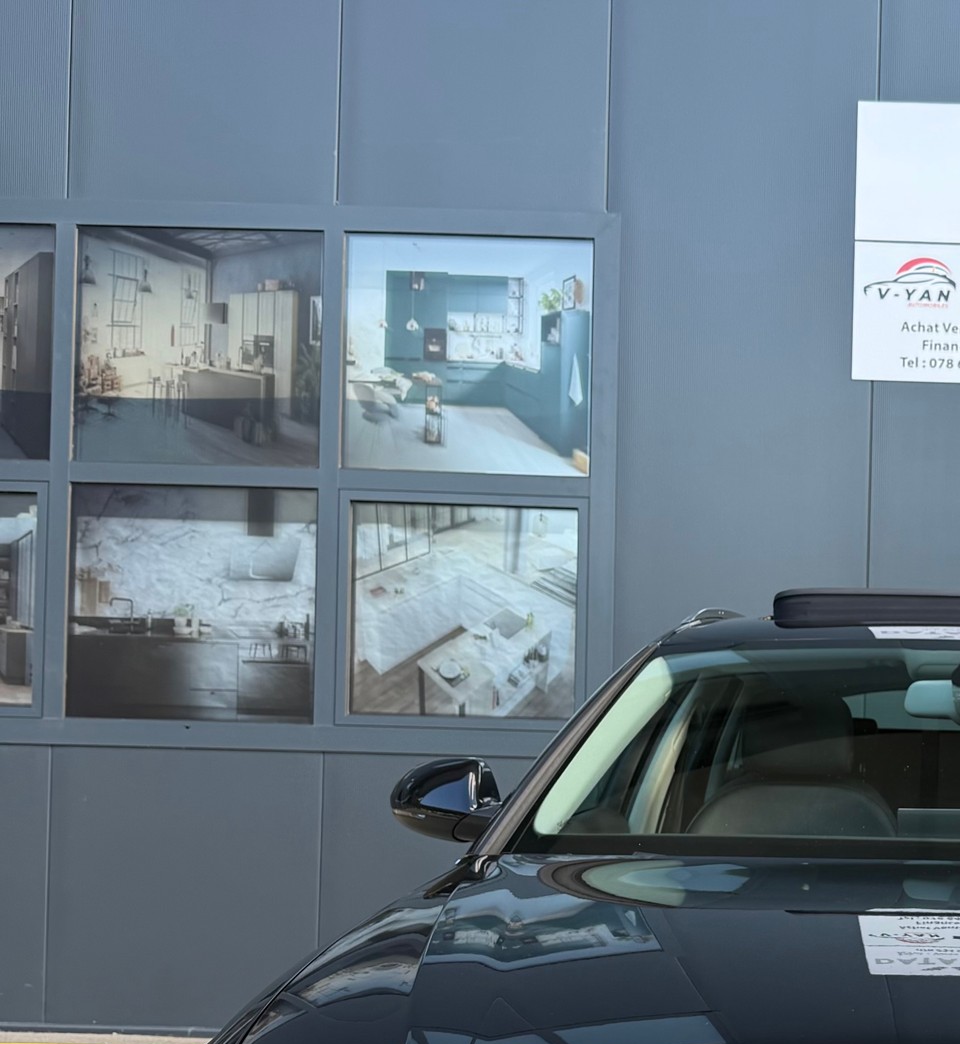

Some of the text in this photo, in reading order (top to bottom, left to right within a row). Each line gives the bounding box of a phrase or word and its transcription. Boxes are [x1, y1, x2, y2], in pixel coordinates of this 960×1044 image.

[878, 288, 951, 302] V-YAN
[901, 321, 939, 333] Achat
[929, 358, 954, 369] 078
